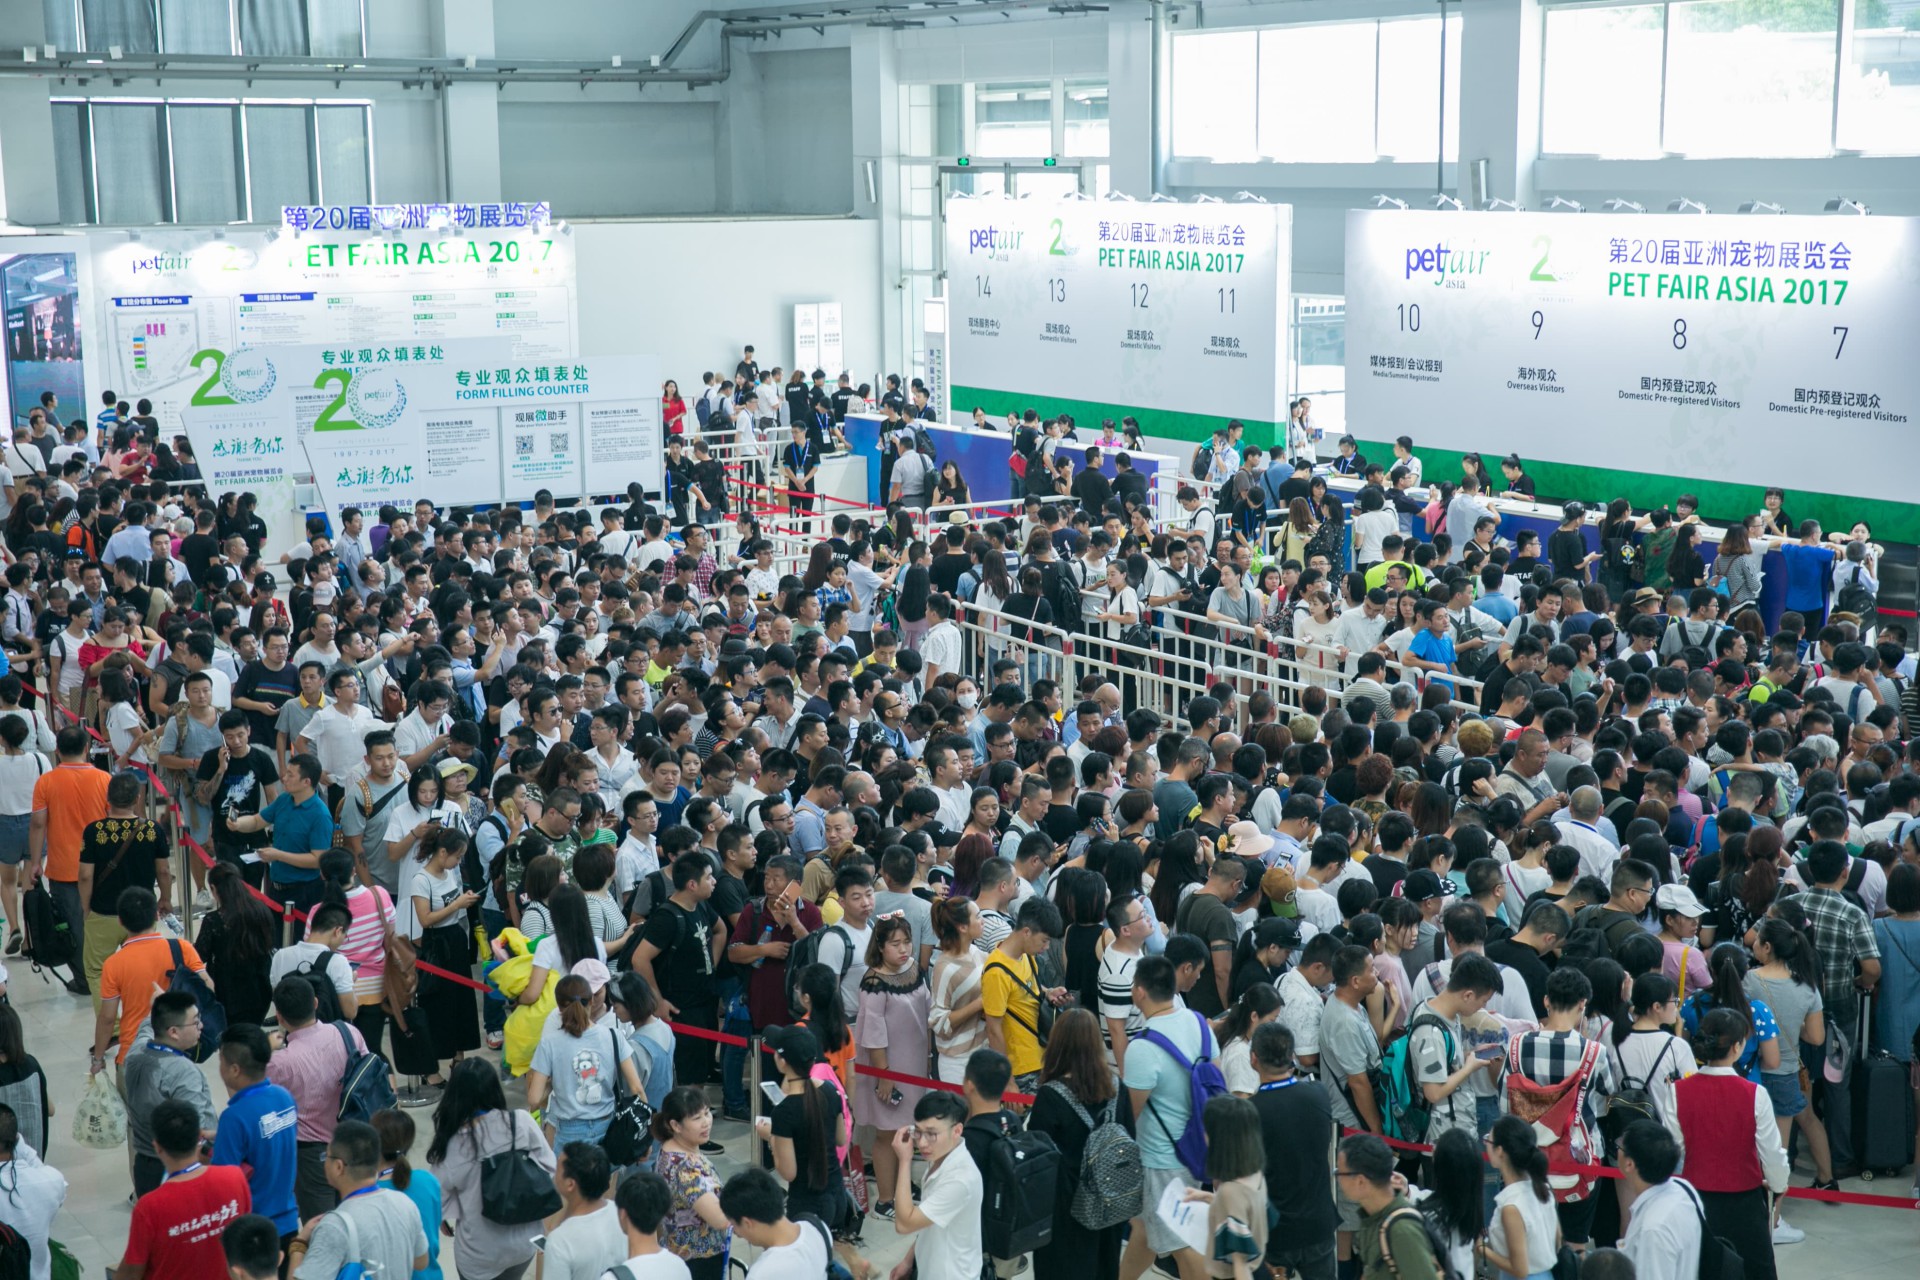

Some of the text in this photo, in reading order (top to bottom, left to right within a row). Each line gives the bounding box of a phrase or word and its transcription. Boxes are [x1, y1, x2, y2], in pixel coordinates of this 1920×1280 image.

[1099, 221, 1245, 246] 第20届亚洲宠物展览会
[1099, 248, 1245, 273] PET FAIR ASIA 2017
[1609, 238, 1852, 271] 第20届亚洲宠物展览会
[976, 275, 992, 298] 14
[1048, 278, 1066, 303] 13
[1131, 282, 1149, 308] 12
[1608, 272, 1848, 306] PET FAIR ASIA 2017
[1219, 288, 1235, 314] 11
[1398, 303, 1420, 332] 10
[1531, 310, 1544, 340] 9
[970, 328, 999, 338] Service Center
[1045, 323, 1071, 335] 现场观众
[1127, 330, 1154, 341] 现场观众
[1672, 318, 1687, 350] 8
[1040, 334, 1077, 344] Domestic Visitors
[1120, 341, 1162, 351] Domestic Visitors
[1211, 336, 1240, 349] 现场观众
[1833, 326, 1849, 360] 7
[321, 345, 444, 365] 专业观众填表处
[1203, 347, 1248, 359] Domestic Visitors
[1370, 355, 1443, 373] 媒体报到/会议报到
[455, 365, 589, 387] 专业观众填表处
[1373, 370, 1440, 382] Media/Summit Registration
[1518, 366, 1557, 383] 海外观众
[456, 384, 589, 400] FORM FILLING COUNTER
[1507, 380, 1565, 394] Overseas Visitors
[1640, 376, 1717, 396] 国内预登记观众
[1618, 390, 1741, 409] Domestic Pre-registered Visitors
[1794, 388, 1881, 409] 国内预登记观众
[515, 409, 567, 422] 观展微助手
[1769, 402, 1907, 423] Domestic Pre-registered Visitors
[209, 421, 266, 430] 1997-2017
[334, 448, 395, 457] 1997-2017
[214, 467, 283, 478] 第20届亚洲宠物展览会
[214, 475, 283, 486] PET FAIR ASIA 2017
